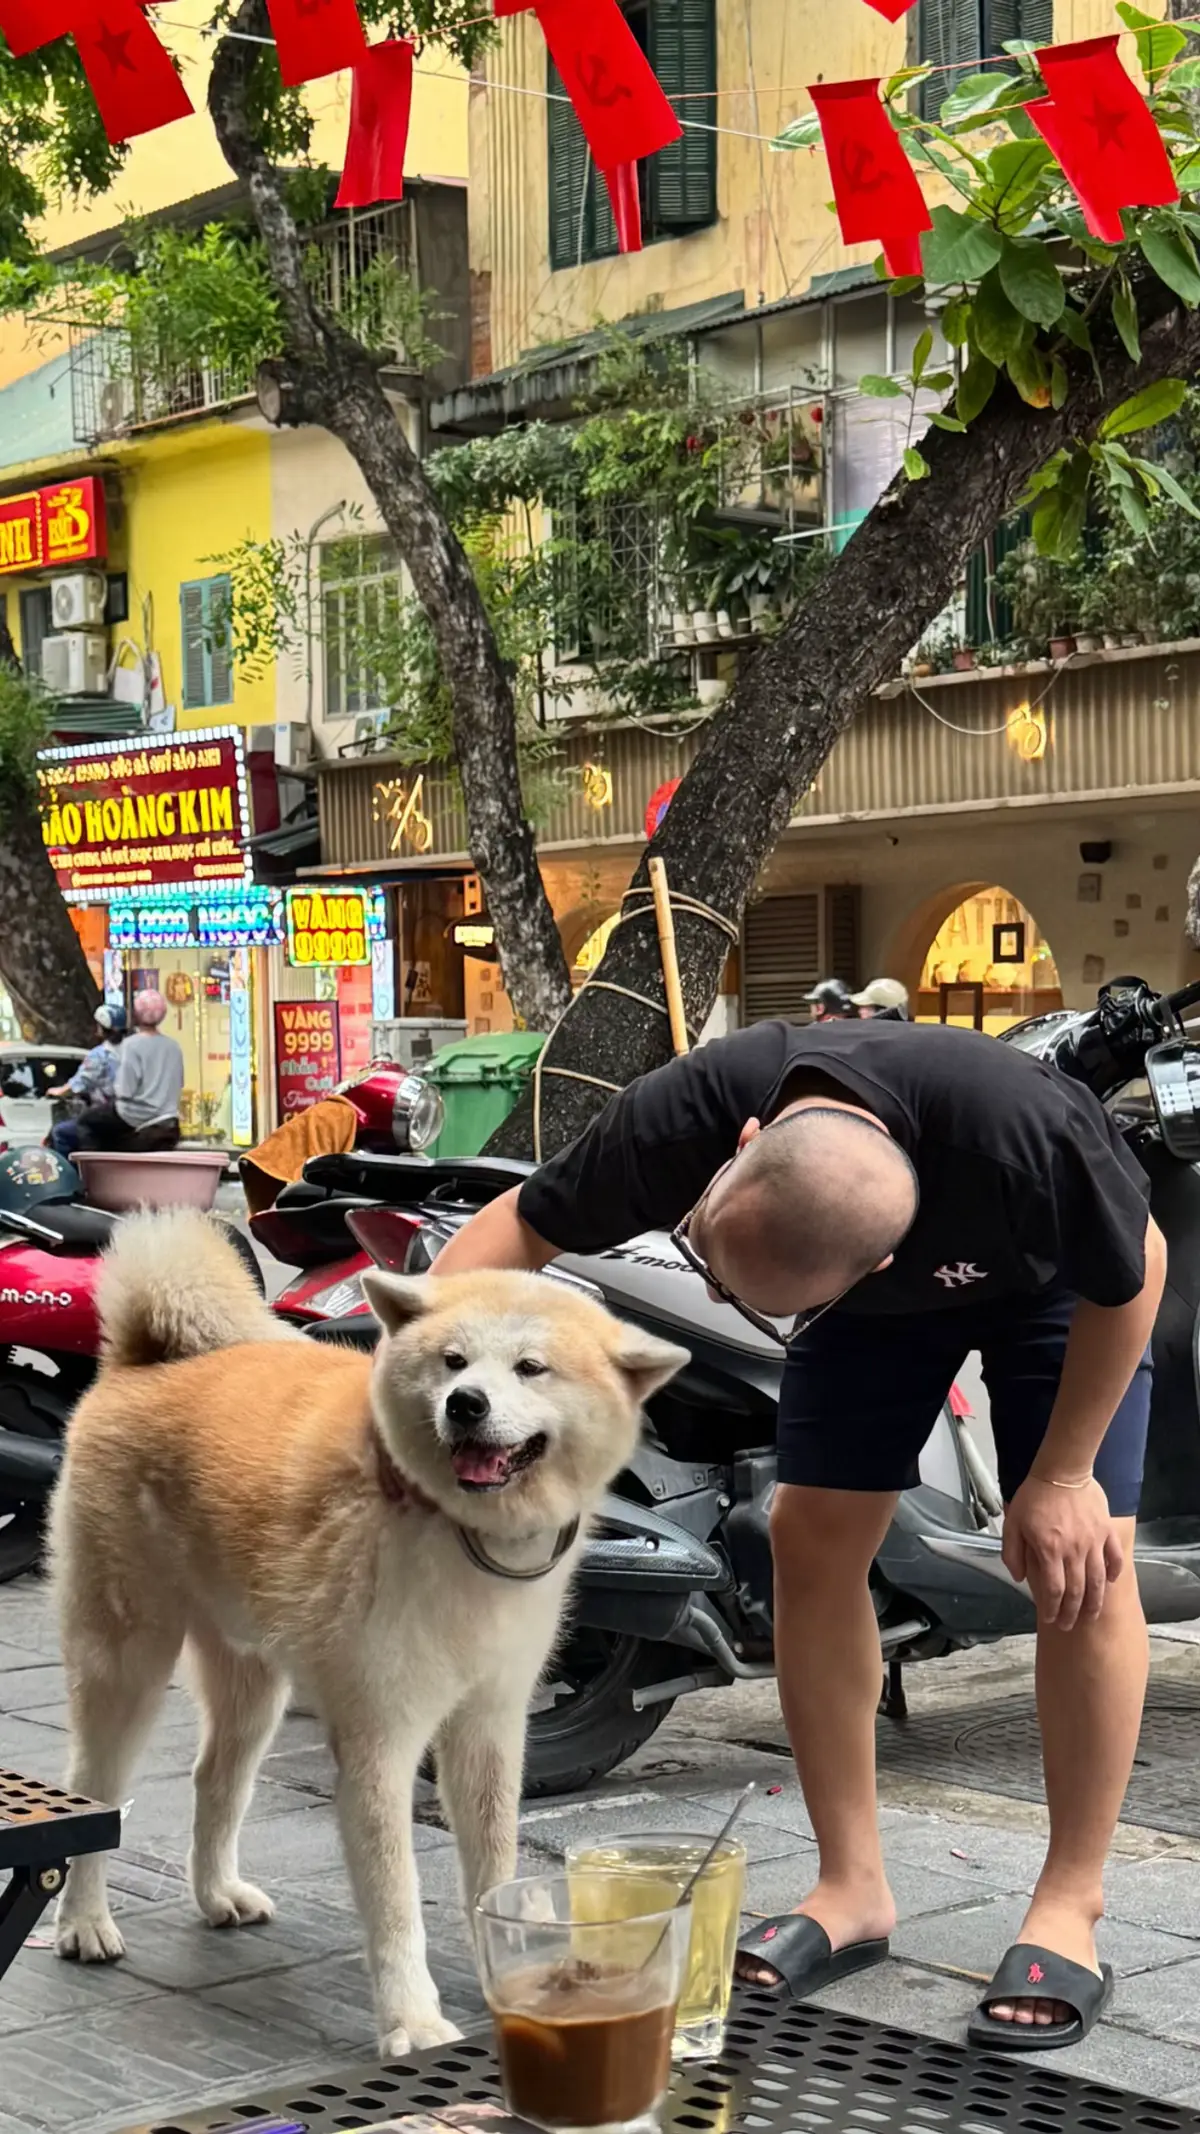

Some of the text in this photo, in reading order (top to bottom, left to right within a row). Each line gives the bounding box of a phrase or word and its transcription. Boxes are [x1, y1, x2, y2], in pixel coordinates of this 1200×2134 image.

[84, 785, 177, 843] HOÀNG
[178, 786, 234, 835] KIM
[293, 894, 363, 930] VÀNG
[295, 931, 364, 961] 9999
[281, 1005, 332, 1030] VÀNG
[284, 1031, 334, 1055] 9999
